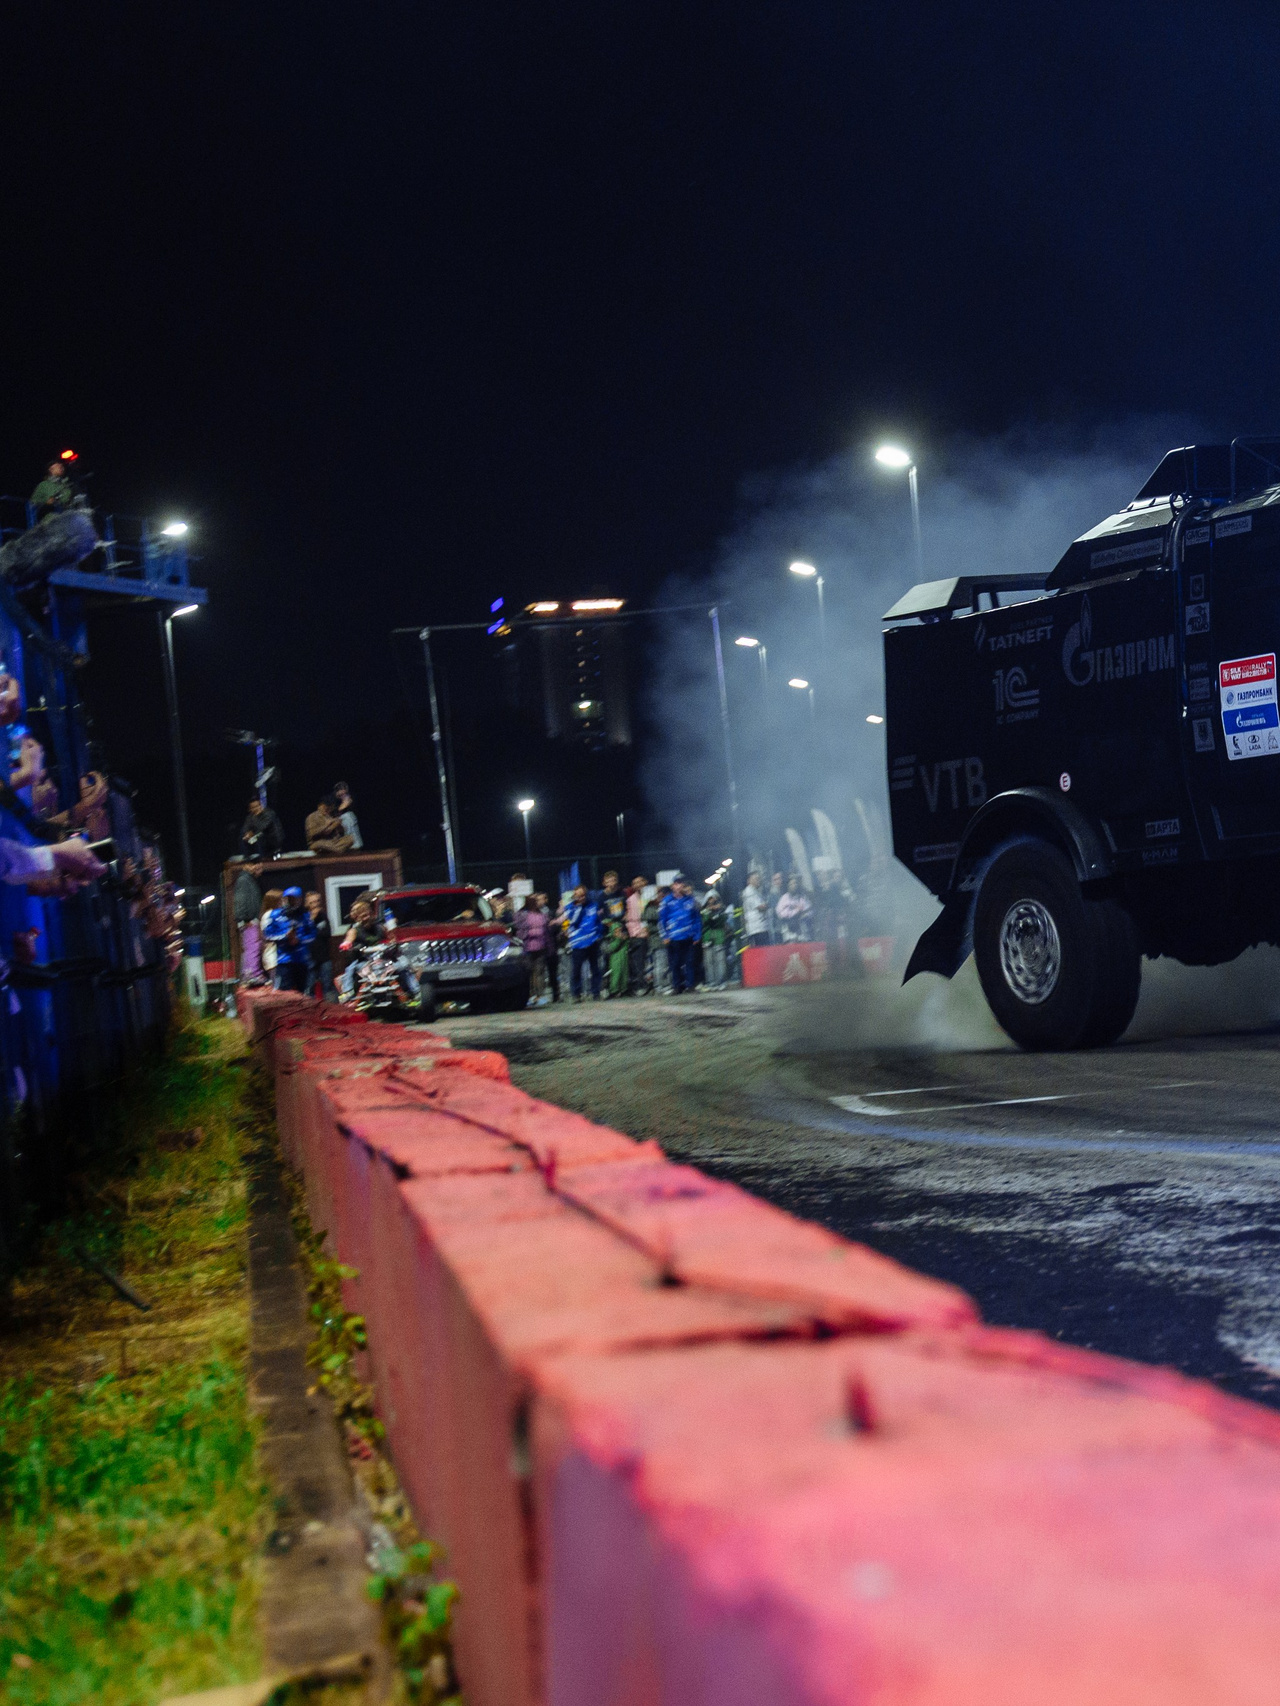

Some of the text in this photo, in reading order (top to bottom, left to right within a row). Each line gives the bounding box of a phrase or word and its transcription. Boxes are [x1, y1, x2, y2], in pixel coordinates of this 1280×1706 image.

[988, 625, 1053, 651] TATNEFT
[1096, 634, 1175, 683] ГАЗПРОМ
[1251, 661, 1267, 671] RALLY
[1237, 687, 1273, 701] ГАЗПРОМБАНК
[919, 756, 988, 813] VTB
